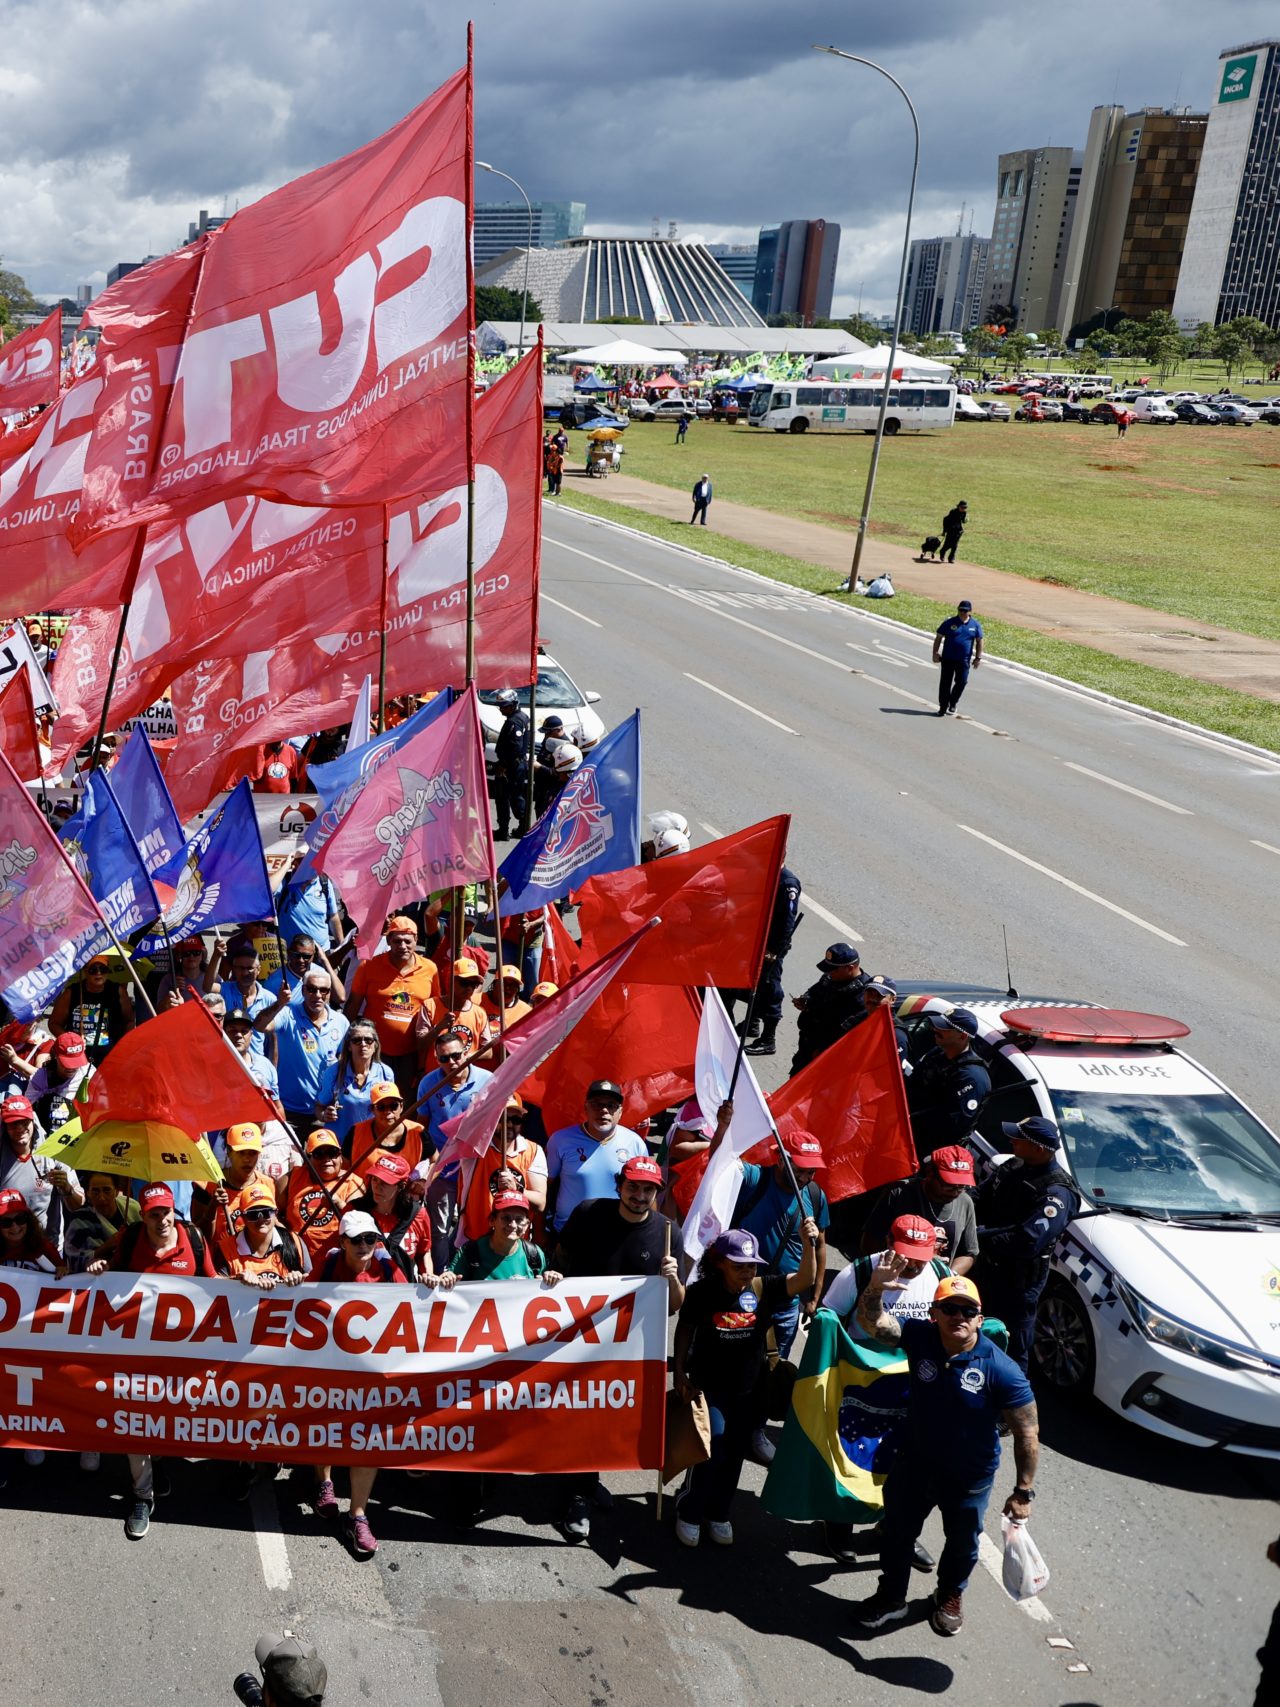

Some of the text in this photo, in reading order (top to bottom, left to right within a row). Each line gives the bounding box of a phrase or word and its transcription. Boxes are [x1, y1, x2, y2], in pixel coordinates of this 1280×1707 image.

[1224, 83, 1244, 94] INCRA
[30, 1287, 144, 1340] FIM
[150, 1294, 238, 1344] DA
[250, 1298, 509, 1354] ESCALA
[522, 1292, 637, 1346] 6X1
[889, 1302, 908, 1310] VIDA
[909, 1300, 927, 1311] NÃO
[113, 1371, 636, 1412] REDUÇÃO DA JORNADA DE TRABALHO!
[113, 1411, 476, 1452] SEM REDUÇÃO DE SALÁRIO!
